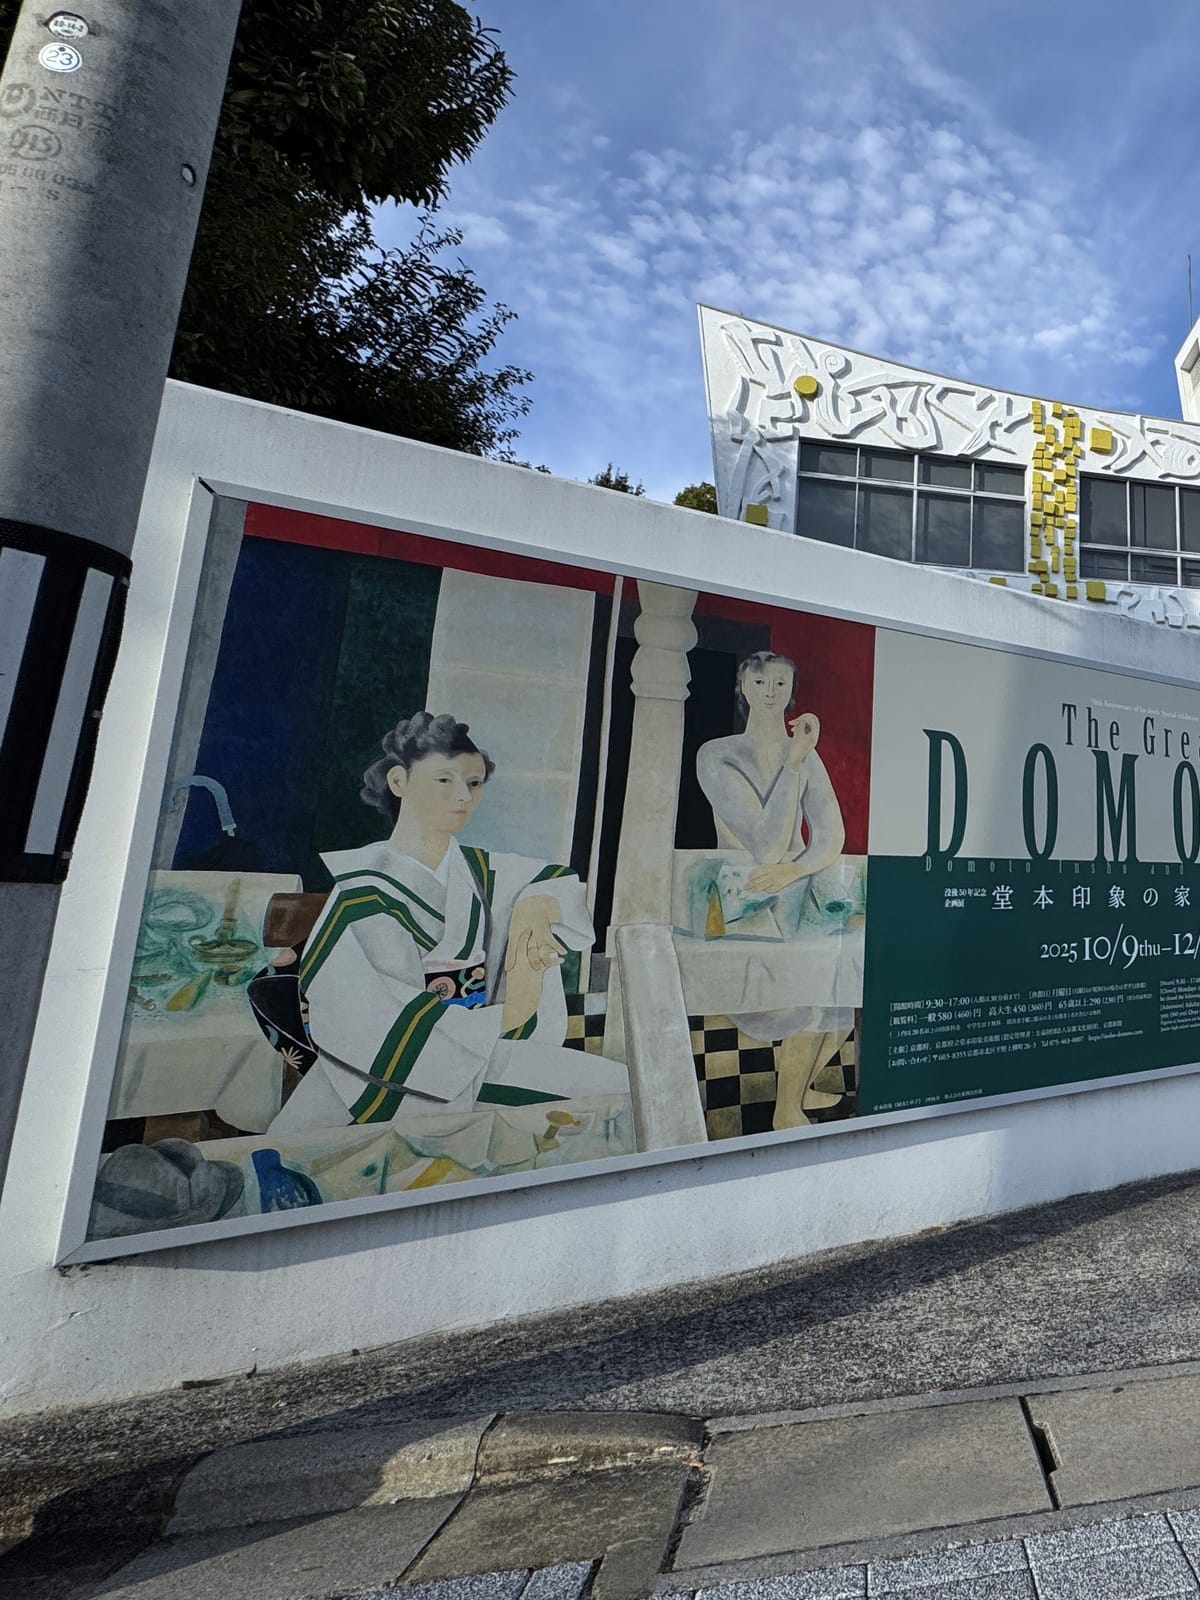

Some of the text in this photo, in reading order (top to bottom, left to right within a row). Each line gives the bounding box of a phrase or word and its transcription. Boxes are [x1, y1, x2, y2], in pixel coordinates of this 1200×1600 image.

[46, 51, 74, 66] 23
[40, 86, 119, 119] NTT
[1062, 703, 1120, 751] The
[926, 856, 1031, 873] Domoto
[1040, 943, 1078, 963] 2025
